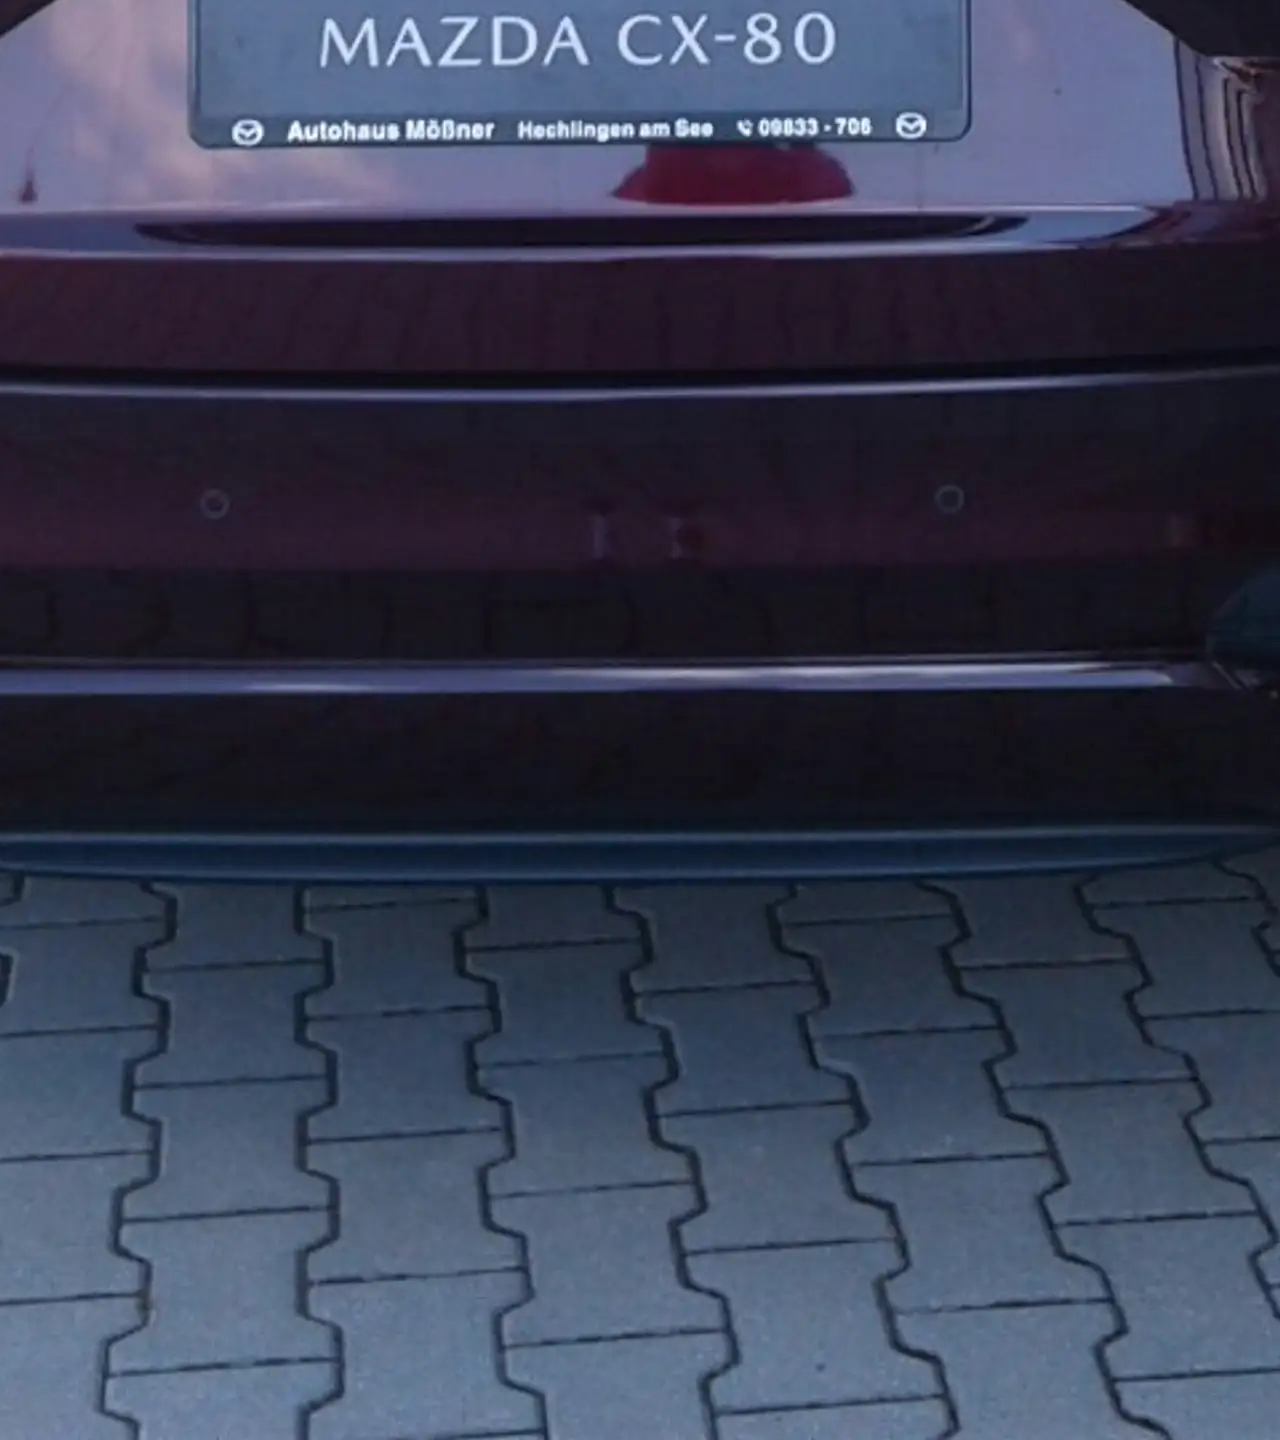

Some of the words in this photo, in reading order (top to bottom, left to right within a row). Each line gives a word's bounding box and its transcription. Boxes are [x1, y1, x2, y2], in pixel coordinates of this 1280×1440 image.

[319, 15, 589, 68] MAZDA
[616, 12, 837, 67] CX-80
[286, 119, 400, 143] Autohaus
[404, 117, 495, 141] Mößner
[517, 119, 635, 143] Hechlingen
[639, 121, 670, 138] am
[674, 117, 714, 138] See
